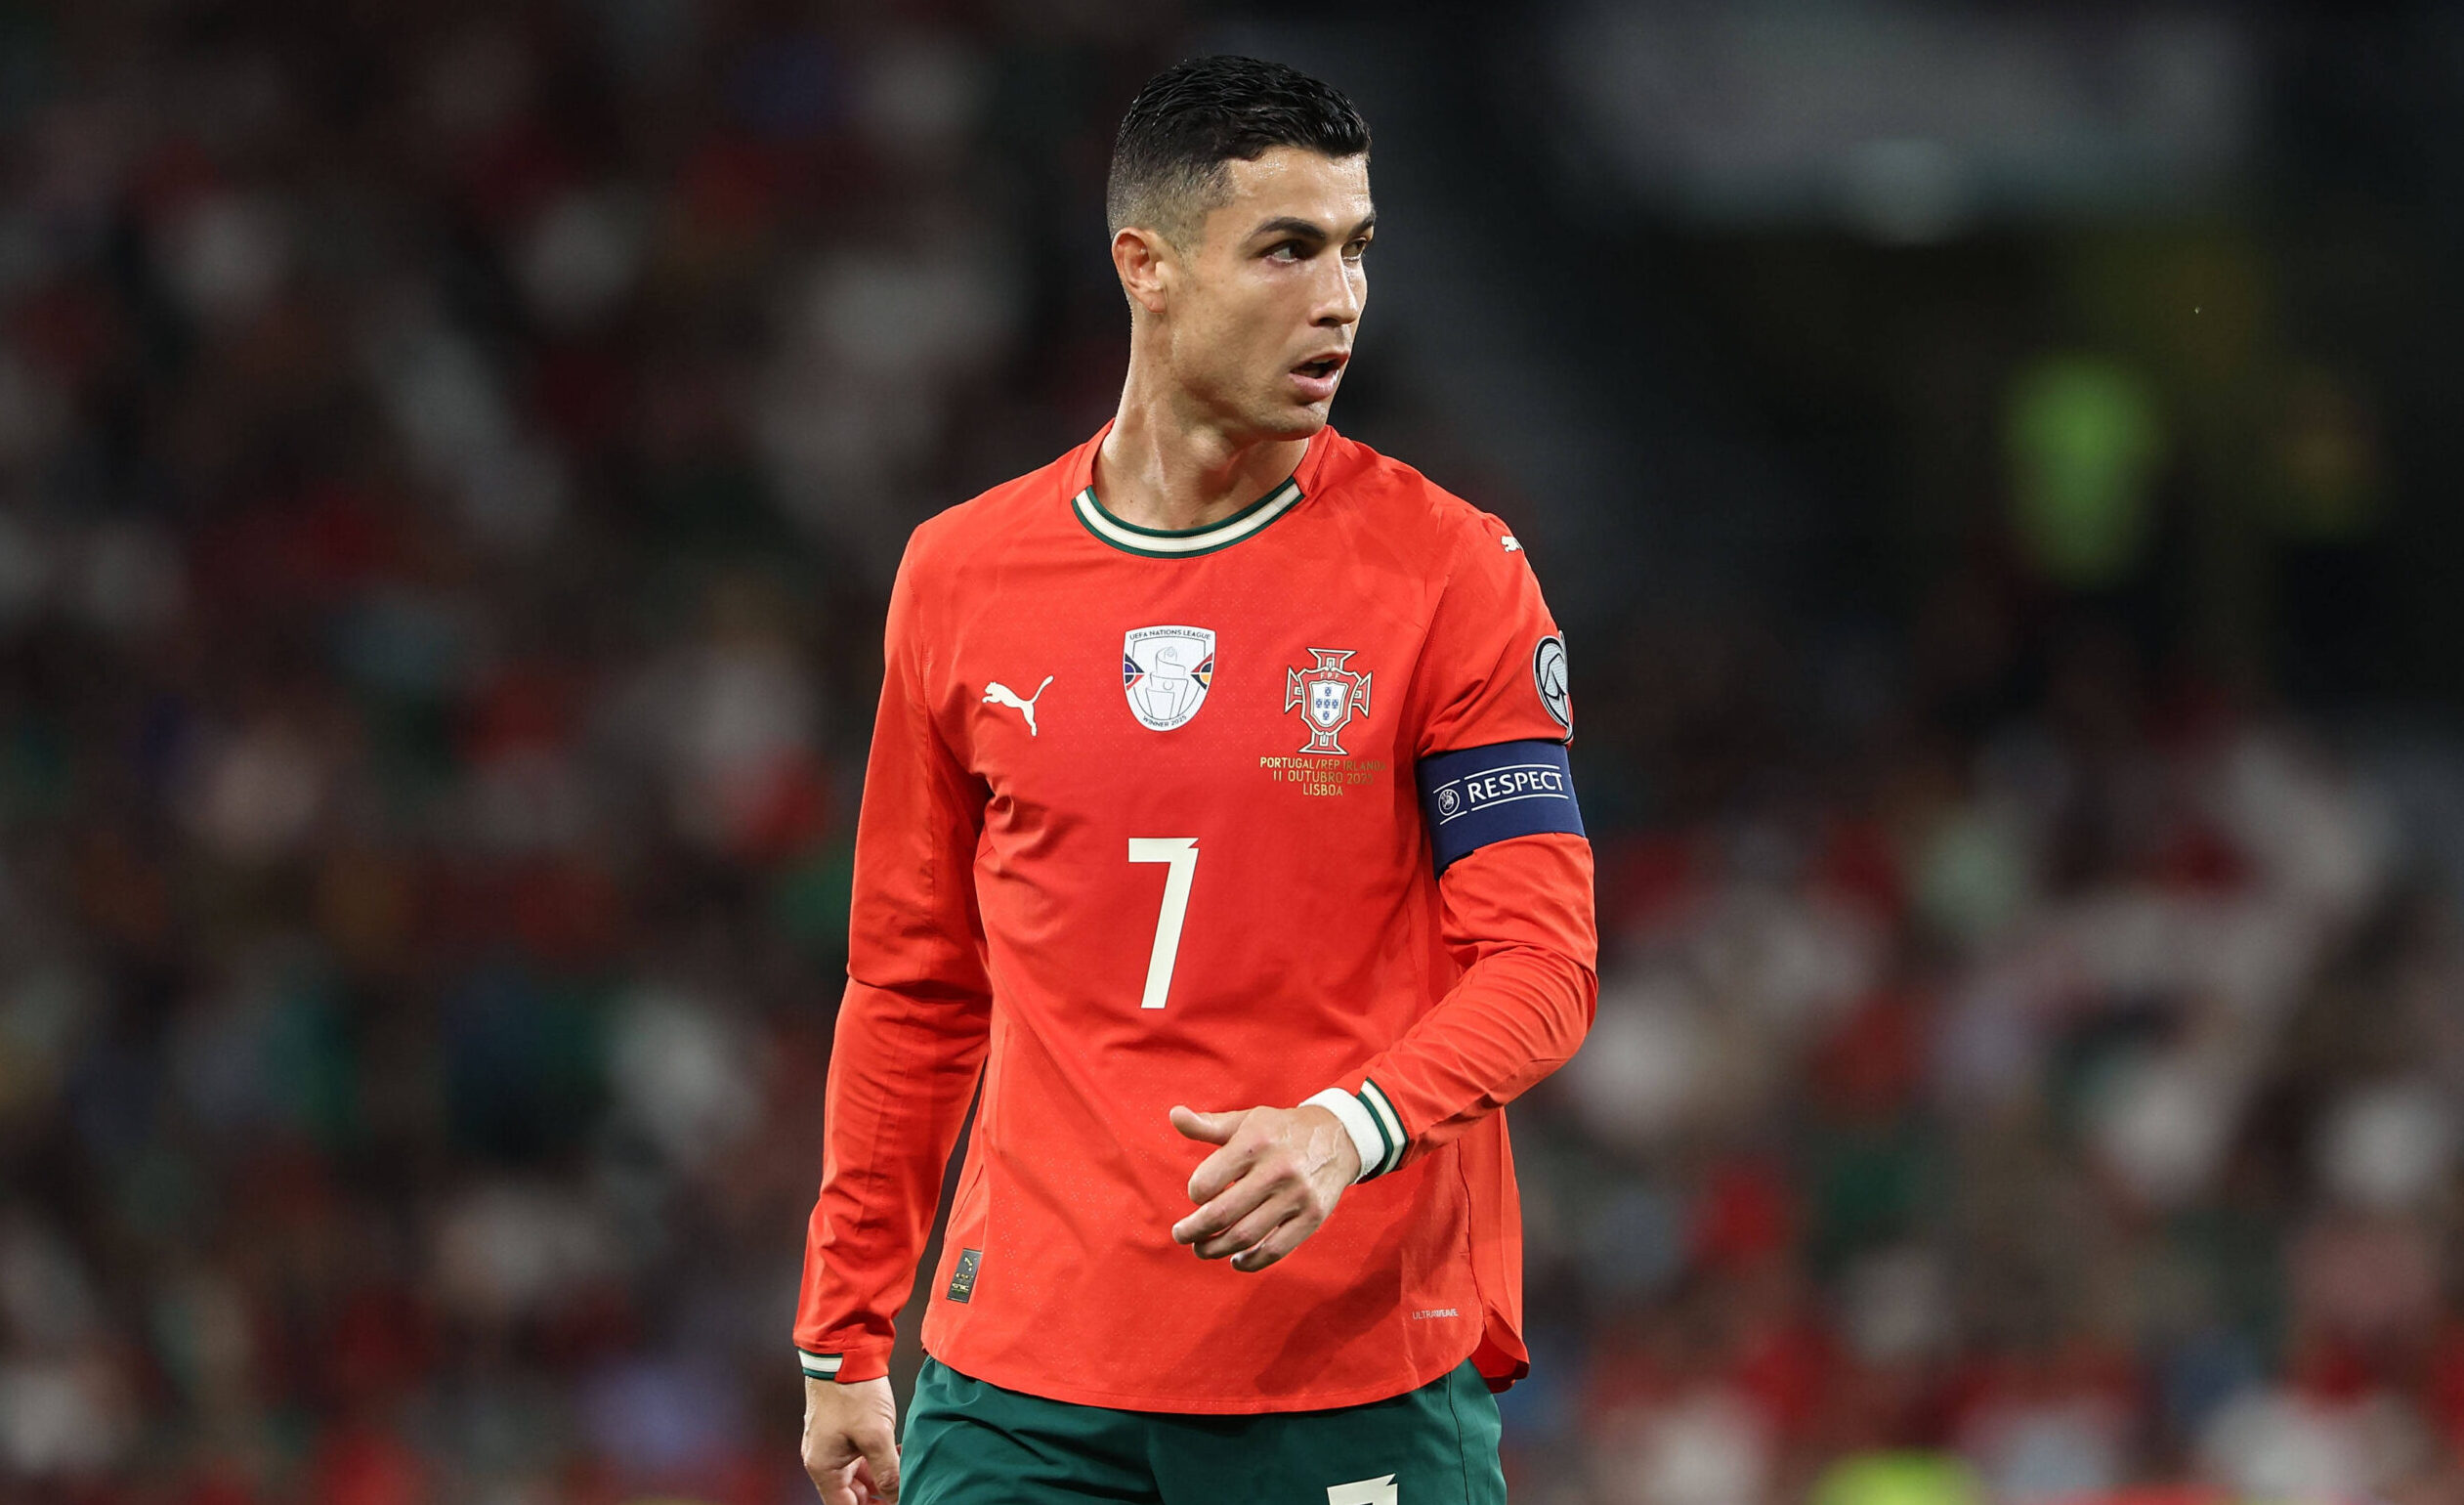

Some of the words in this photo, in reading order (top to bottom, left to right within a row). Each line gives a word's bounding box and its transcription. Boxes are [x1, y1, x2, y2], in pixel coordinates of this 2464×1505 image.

[1183, 629, 1211, 640] LEAGUE
[1143, 715, 1168, 727] WINNER
[1171, 714, 1187, 726] 2025
[1272, 770, 1282, 782] 11
[1288, 770, 1343, 783] OUTUBRO
[1303, 783, 1343, 796] LISBOA
[1467, 771, 1563, 803] RESPECT
[1128, 838, 1200, 1009] 7
